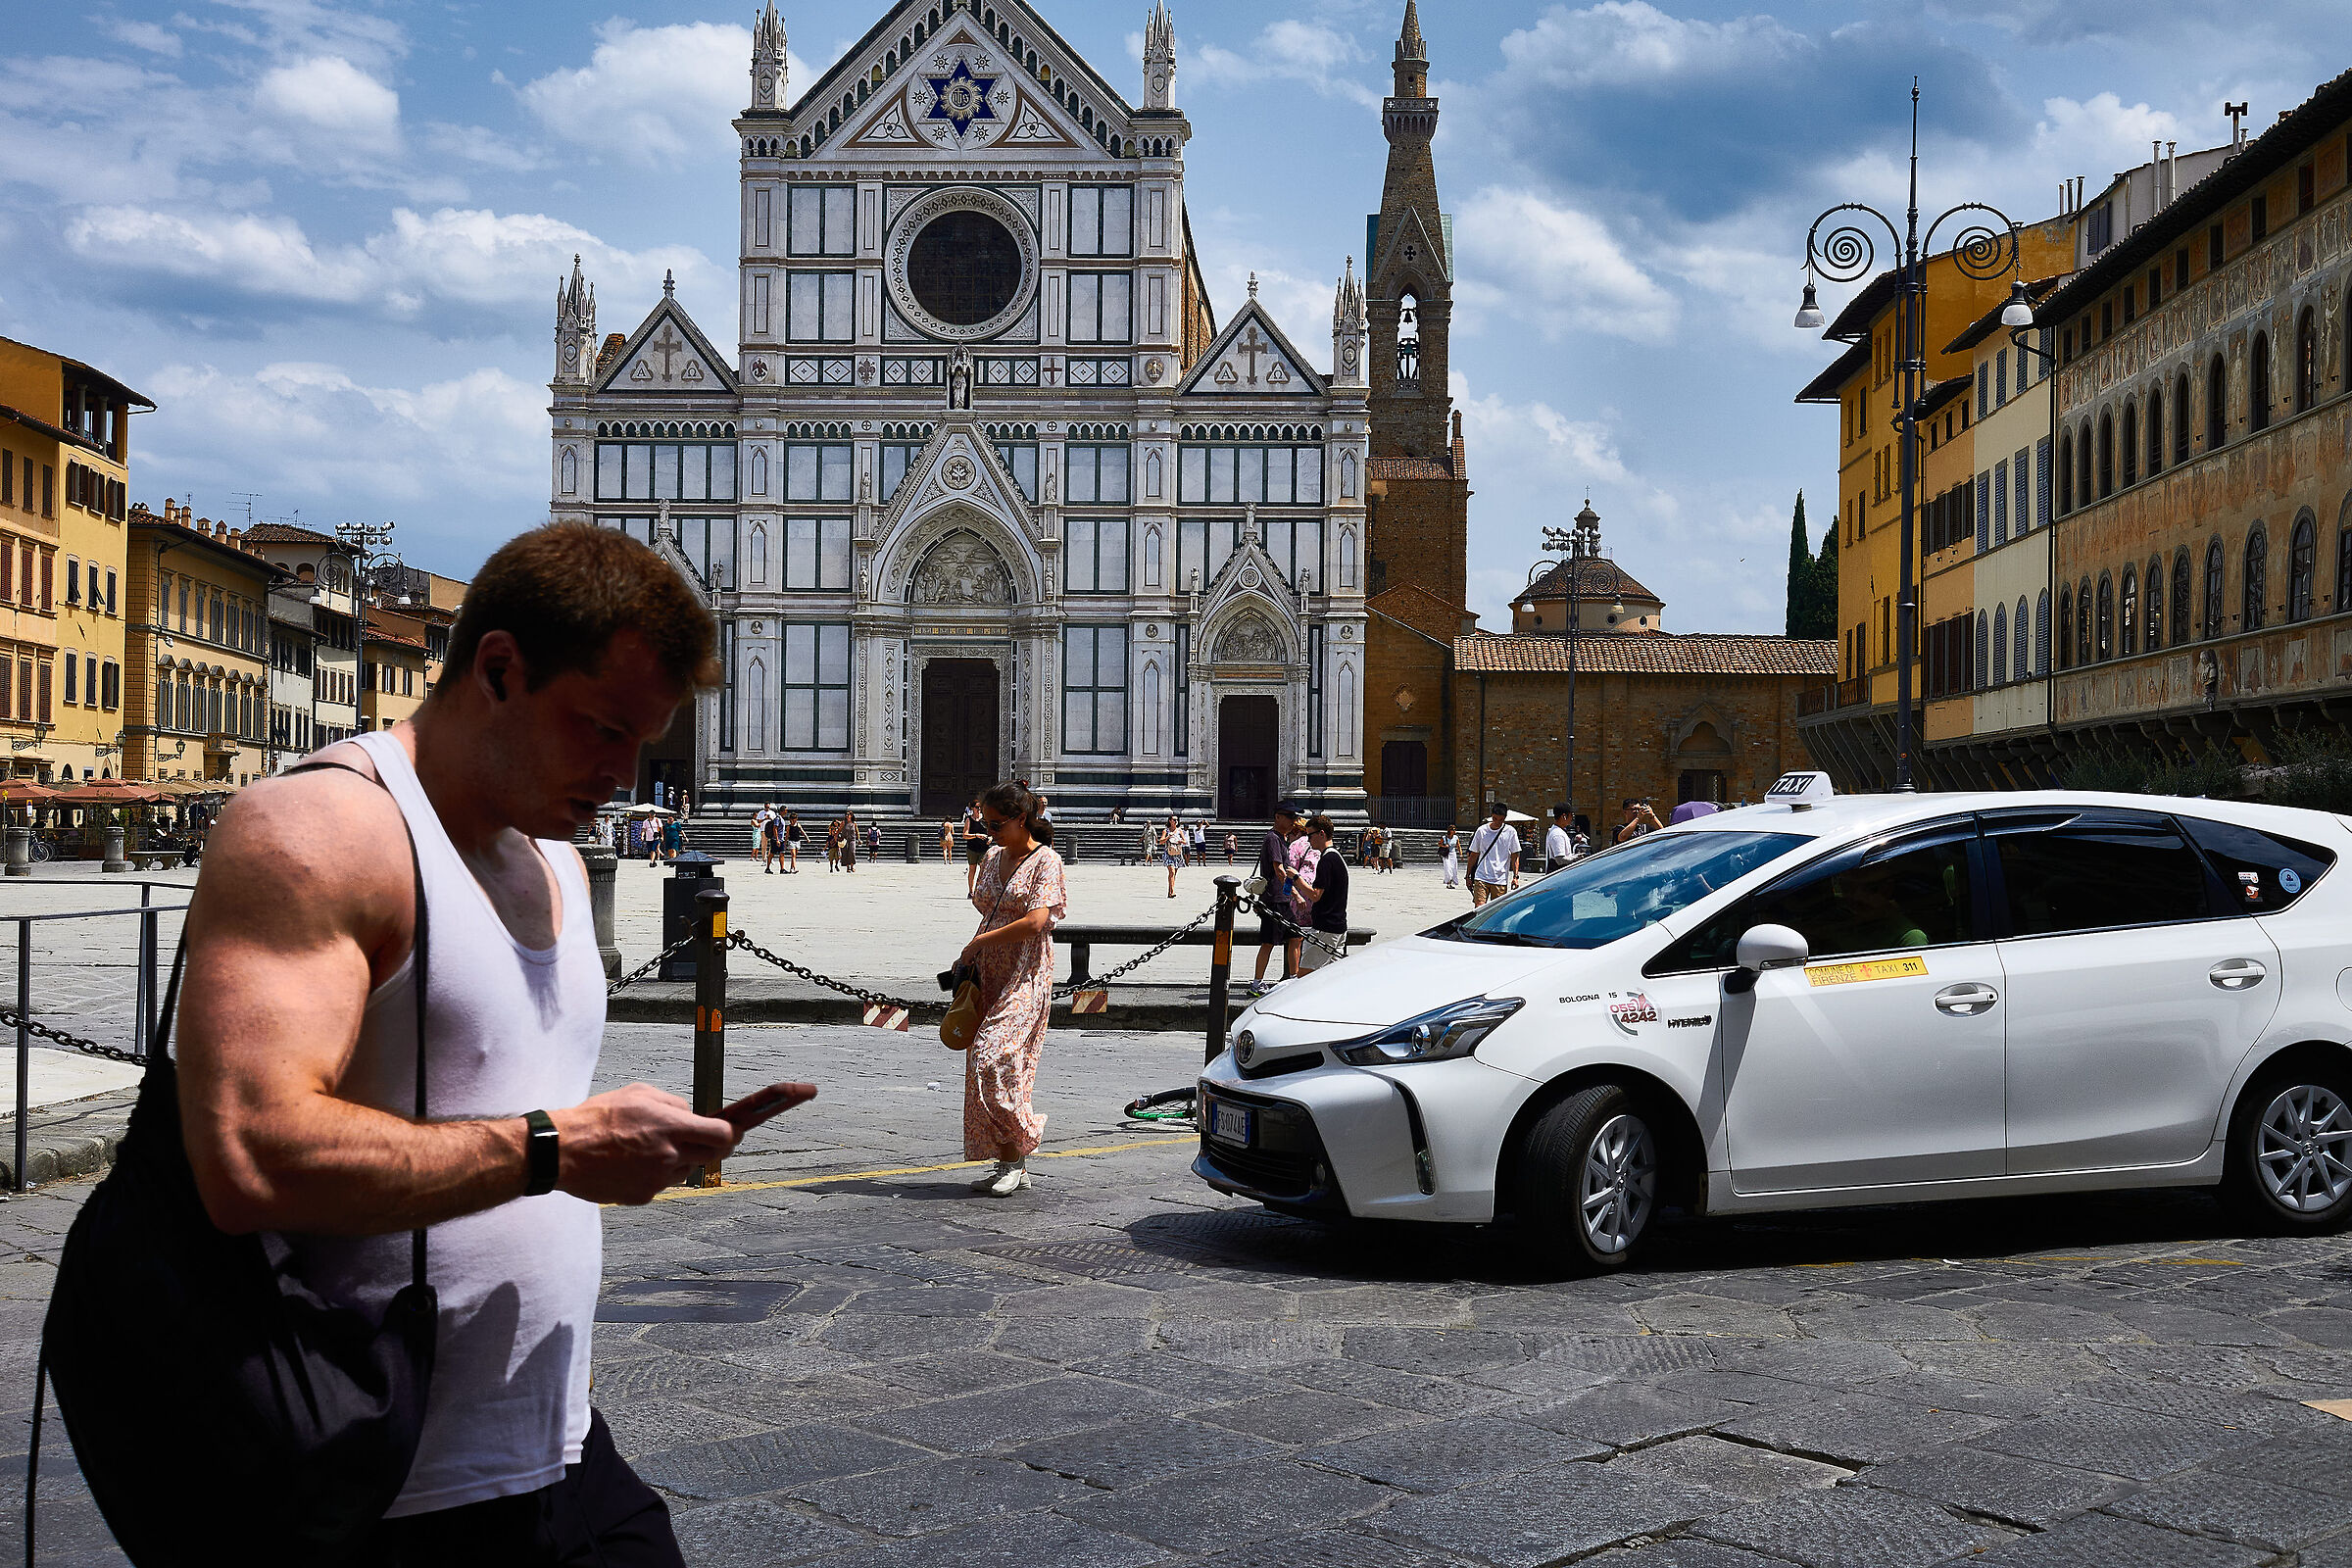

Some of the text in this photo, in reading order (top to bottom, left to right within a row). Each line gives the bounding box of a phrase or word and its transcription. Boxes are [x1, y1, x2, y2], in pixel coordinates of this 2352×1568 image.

[1773, 777, 1812, 793] TAXI
[1808, 964, 1855, 978] COMUNE DI
[1875, 961, 1918, 975] TAXI 311
[1811, 973, 1857, 986] FIRENZE
[1559, 994, 1599, 1004] BOLOGNA
[1609, 1003, 1637, 1013] 055
[1620, 1010, 1657, 1023] 4242
